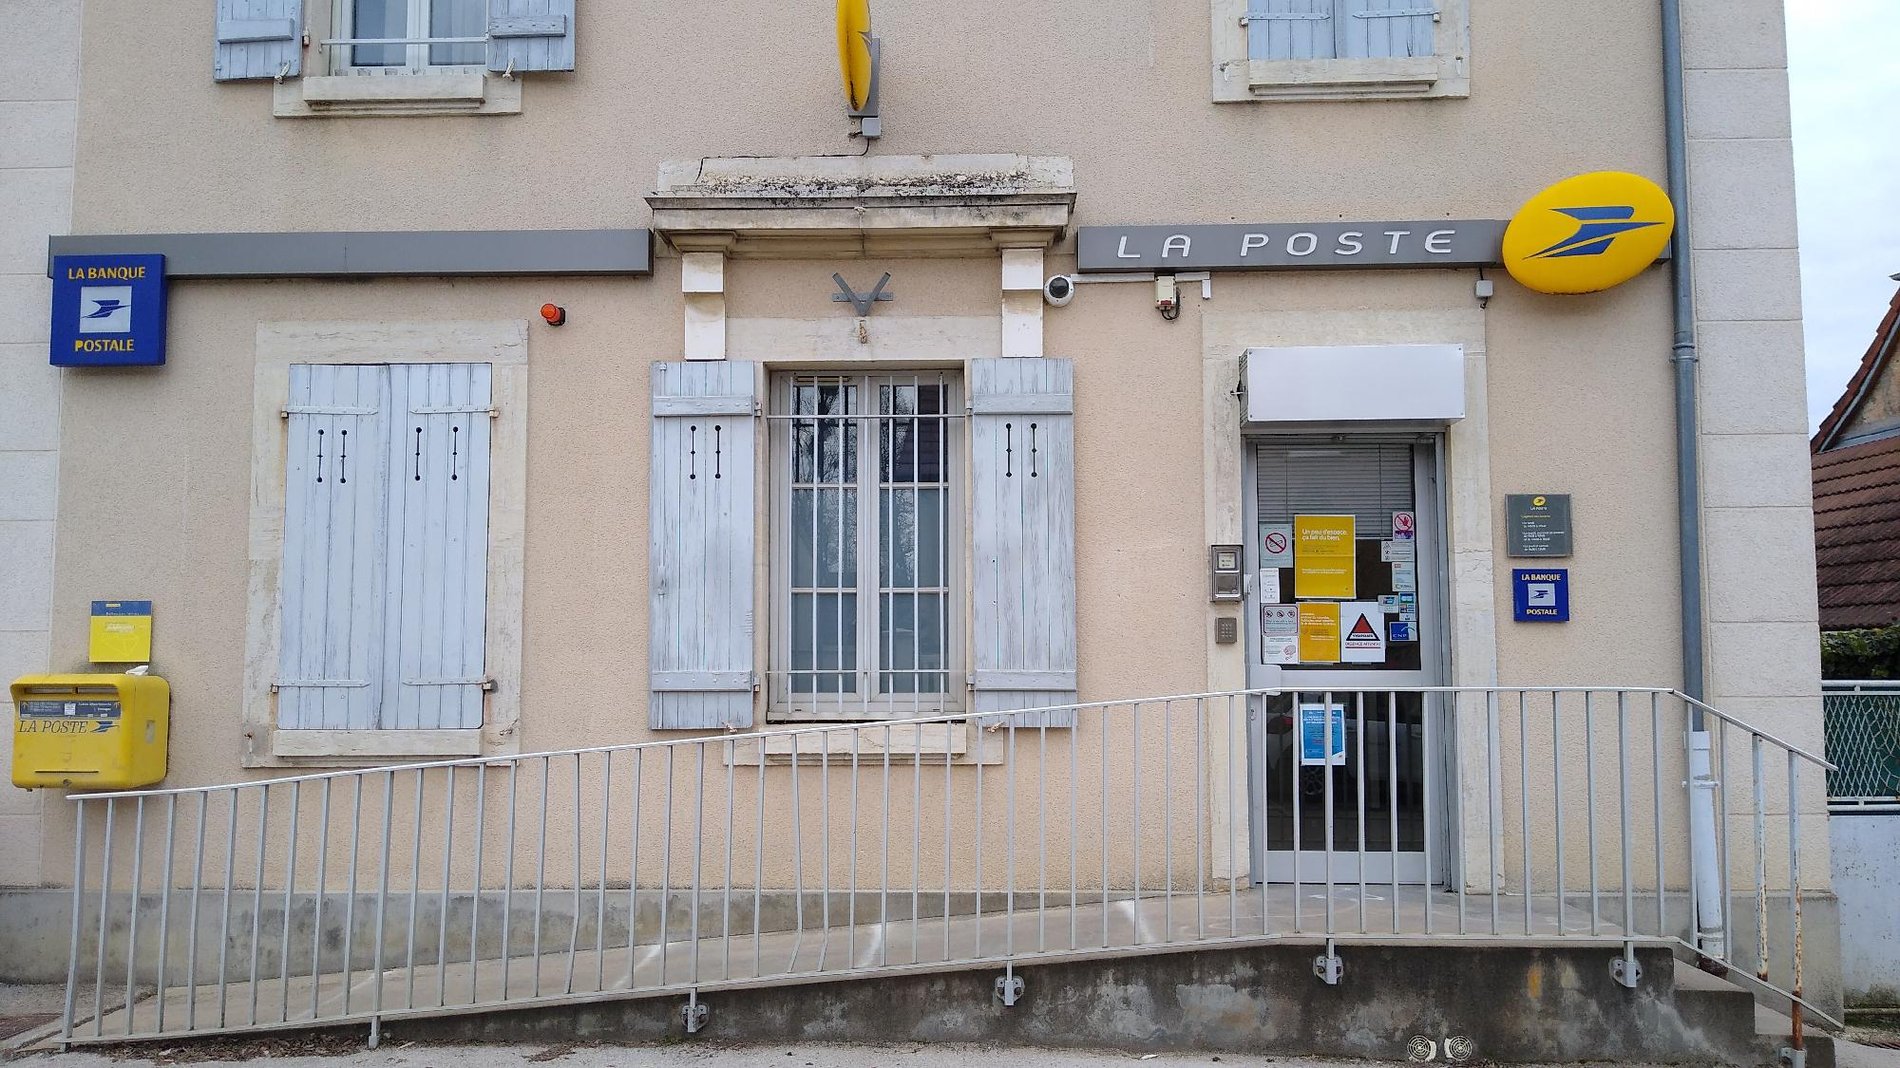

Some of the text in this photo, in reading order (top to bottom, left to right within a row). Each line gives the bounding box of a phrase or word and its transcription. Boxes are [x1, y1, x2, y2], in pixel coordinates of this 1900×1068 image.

[1117, 229, 1456, 258] LA POSTE
[67, 266, 146, 280] LA BANQUE
[74, 339, 135, 352] POSTALE
[1531, 573, 1561, 581] BANQUE
[18, 720, 89, 733] LA POSTE
